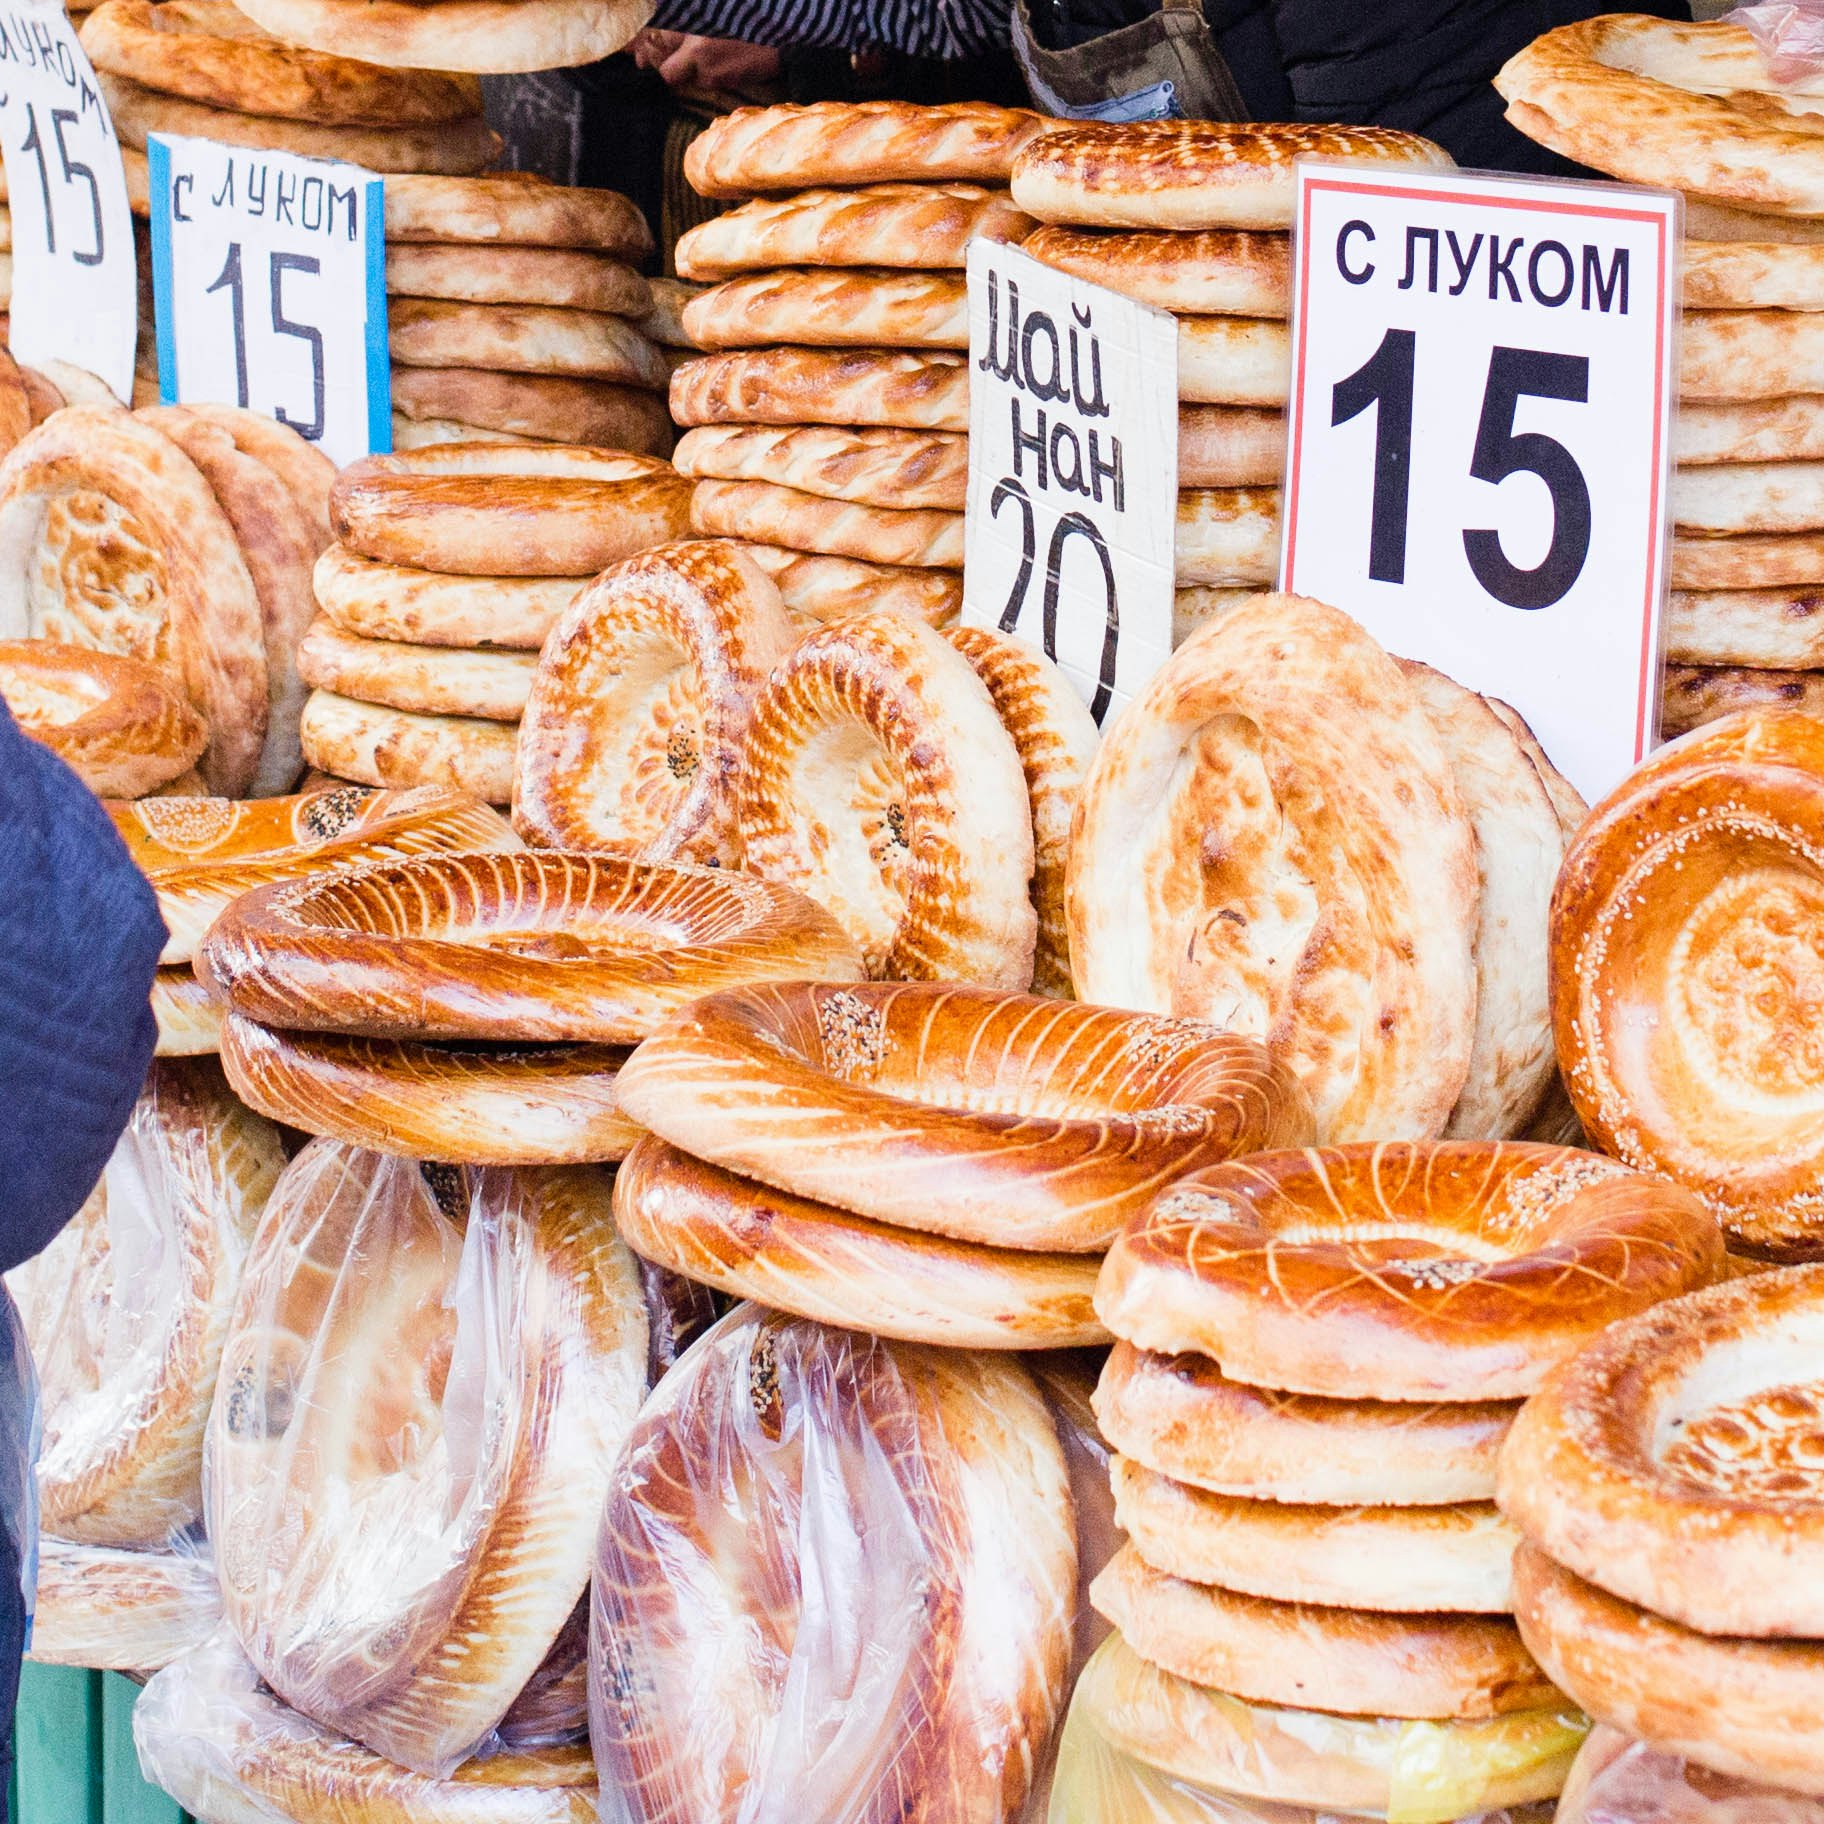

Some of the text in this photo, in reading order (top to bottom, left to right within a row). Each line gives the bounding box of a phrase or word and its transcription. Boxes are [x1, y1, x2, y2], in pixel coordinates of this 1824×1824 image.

[21, 100, 105, 266] 15
[212, 157, 357, 242] ЛУКОМ
[1336, 219, 1630, 315] С ЛУКОМ
[206, 241, 325, 441] 15
[1330, 327, 1592, 612] 15
[990, 477, 1121, 729] 20
